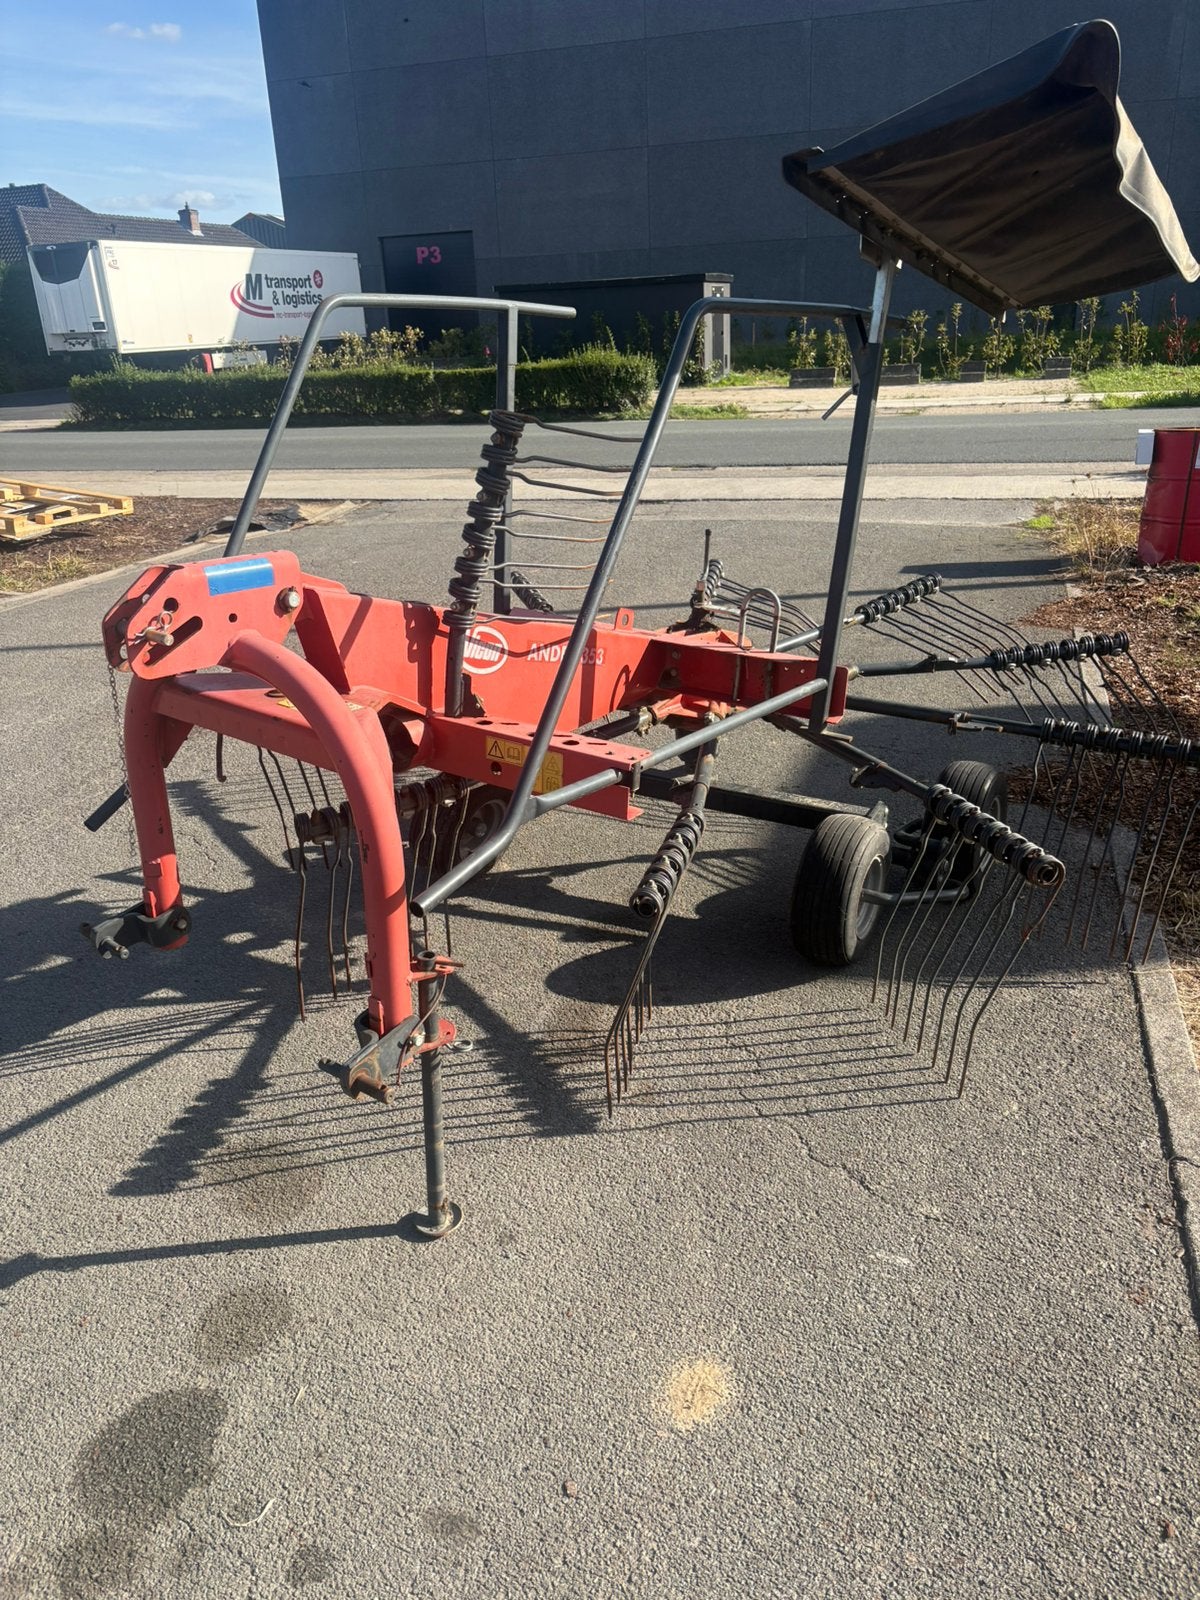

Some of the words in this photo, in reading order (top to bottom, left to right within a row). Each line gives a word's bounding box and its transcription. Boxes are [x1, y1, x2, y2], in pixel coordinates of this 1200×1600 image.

[415, 246, 442, 264] P3
[264, 273, 312, 291] transport
[272, 290, 279, 305] &
[282, 290, 323, 308] logistics
[581, 647, 604, 665] 353
